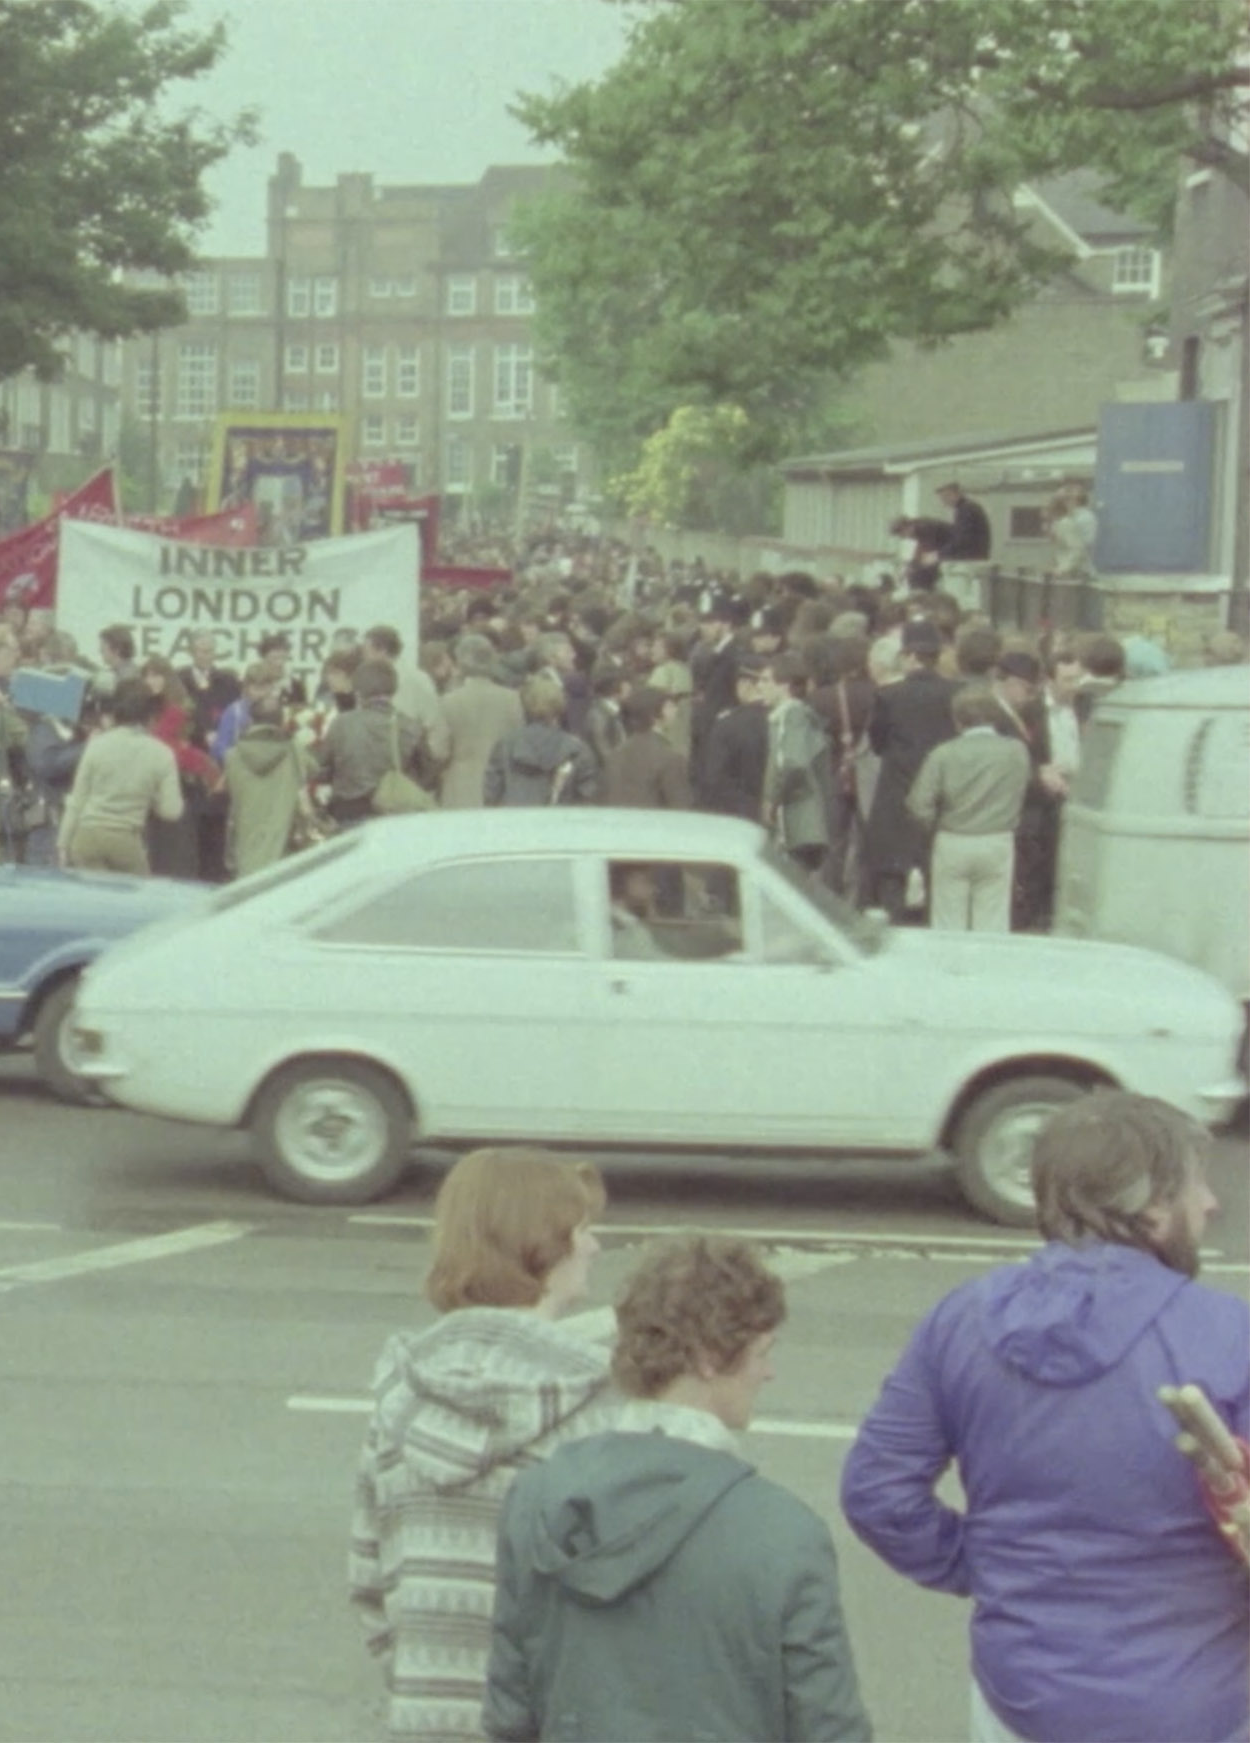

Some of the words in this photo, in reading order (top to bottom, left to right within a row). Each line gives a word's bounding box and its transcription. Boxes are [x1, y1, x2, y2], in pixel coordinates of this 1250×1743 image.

[160, 546, 307, 576] INNER
[132, 585, 340, 623] LONDON
[126, 626, 358, 662] EACHR
